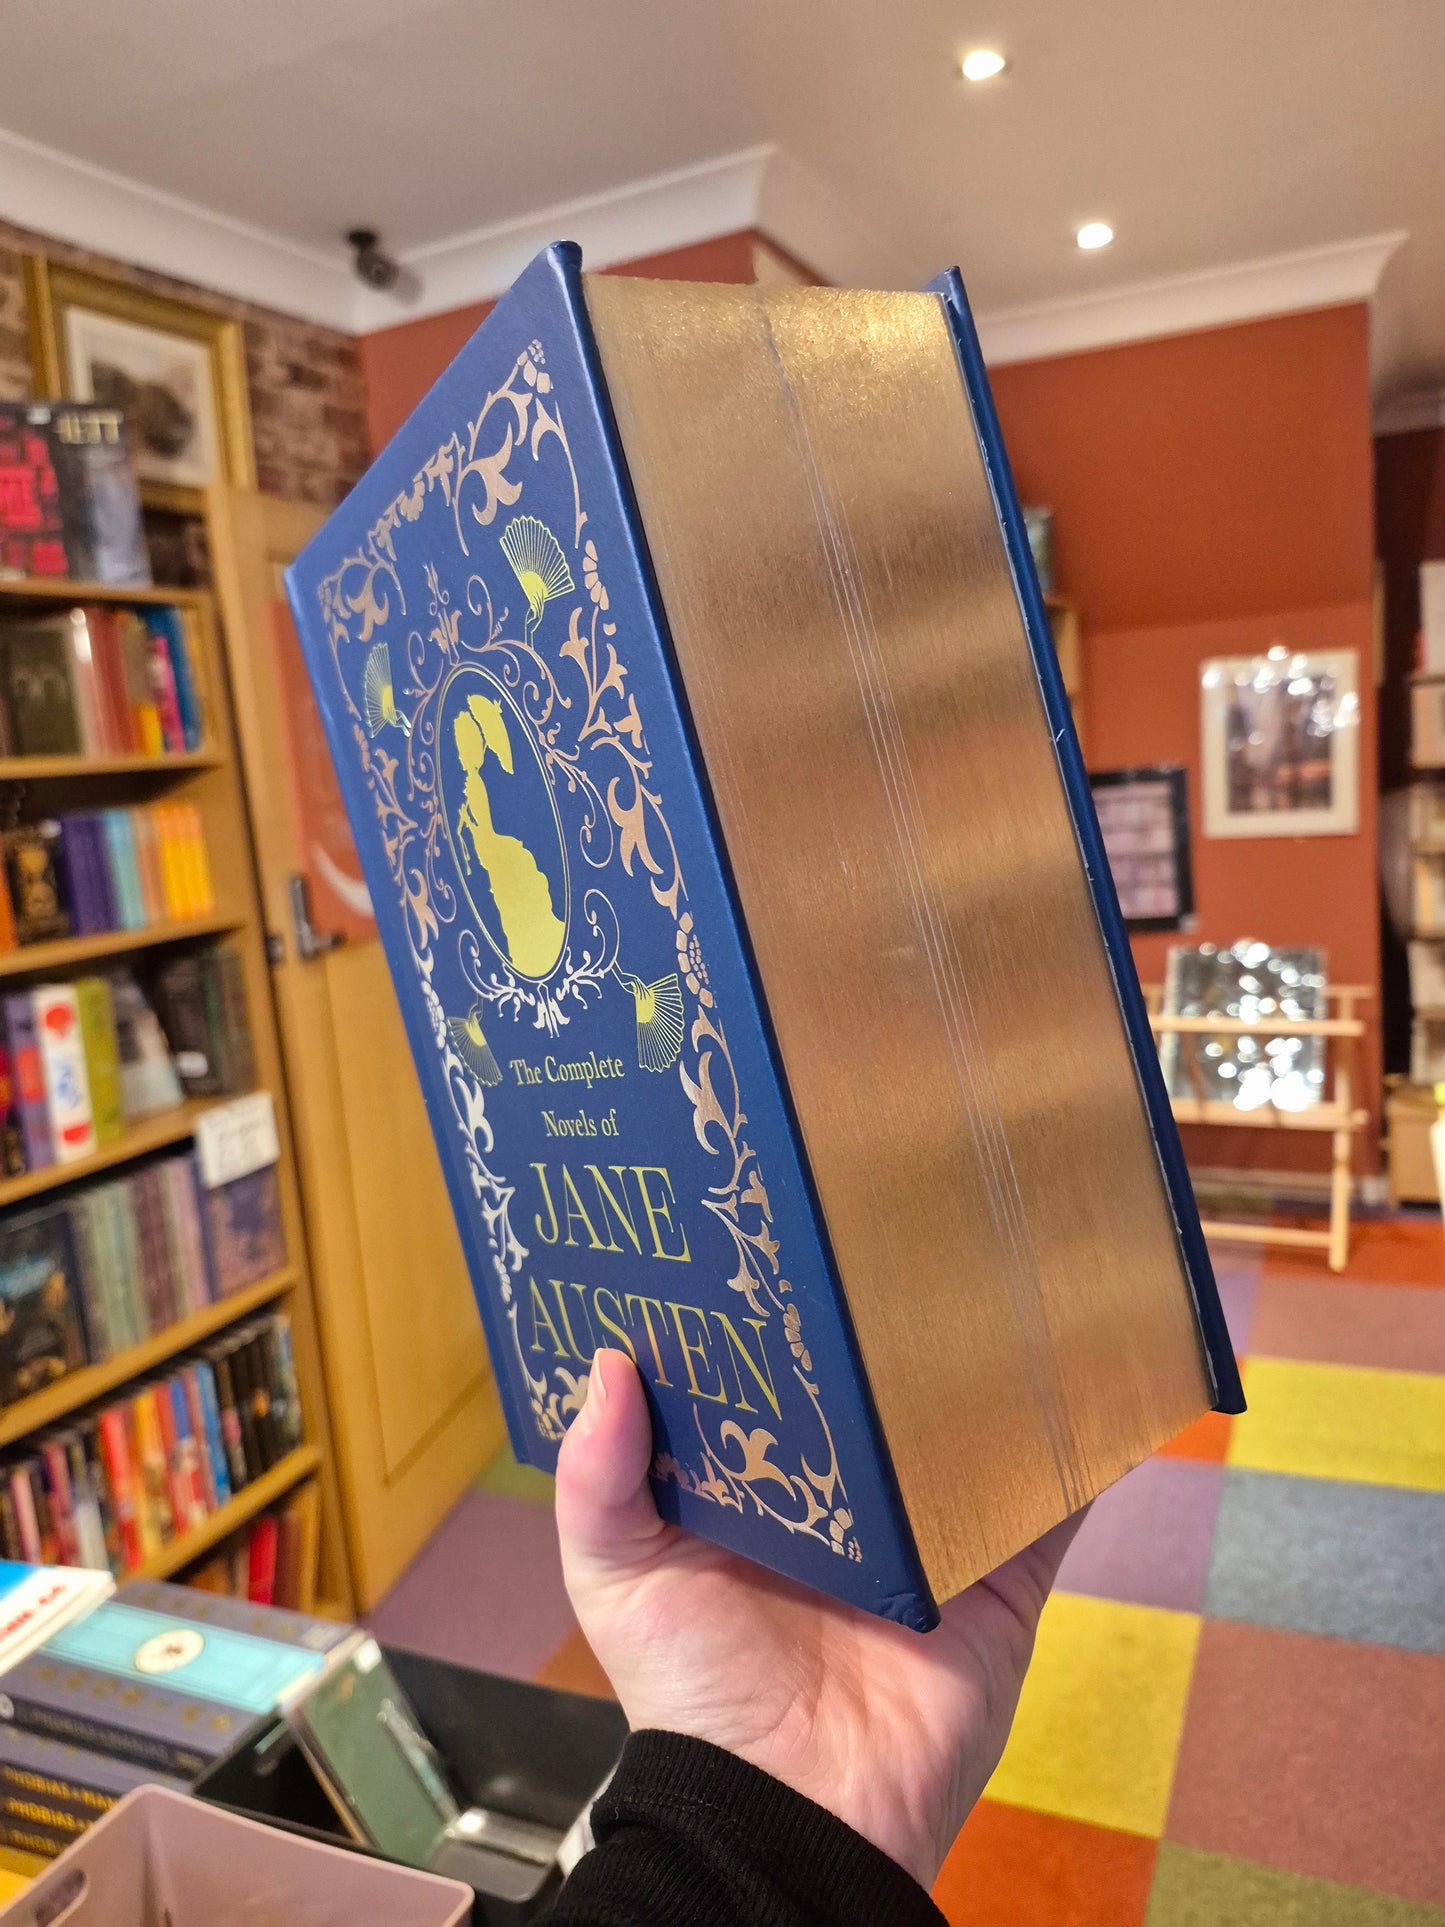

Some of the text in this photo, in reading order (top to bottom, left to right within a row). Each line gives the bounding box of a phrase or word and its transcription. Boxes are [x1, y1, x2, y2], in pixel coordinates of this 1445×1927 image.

[509, 1051, 625, 1088] The Complete
[540, 1108, 619, 1137] Novels of
[529, 1163, 691, 1262] JANE
[530, 1275, 782, 1421] AUSTEN
